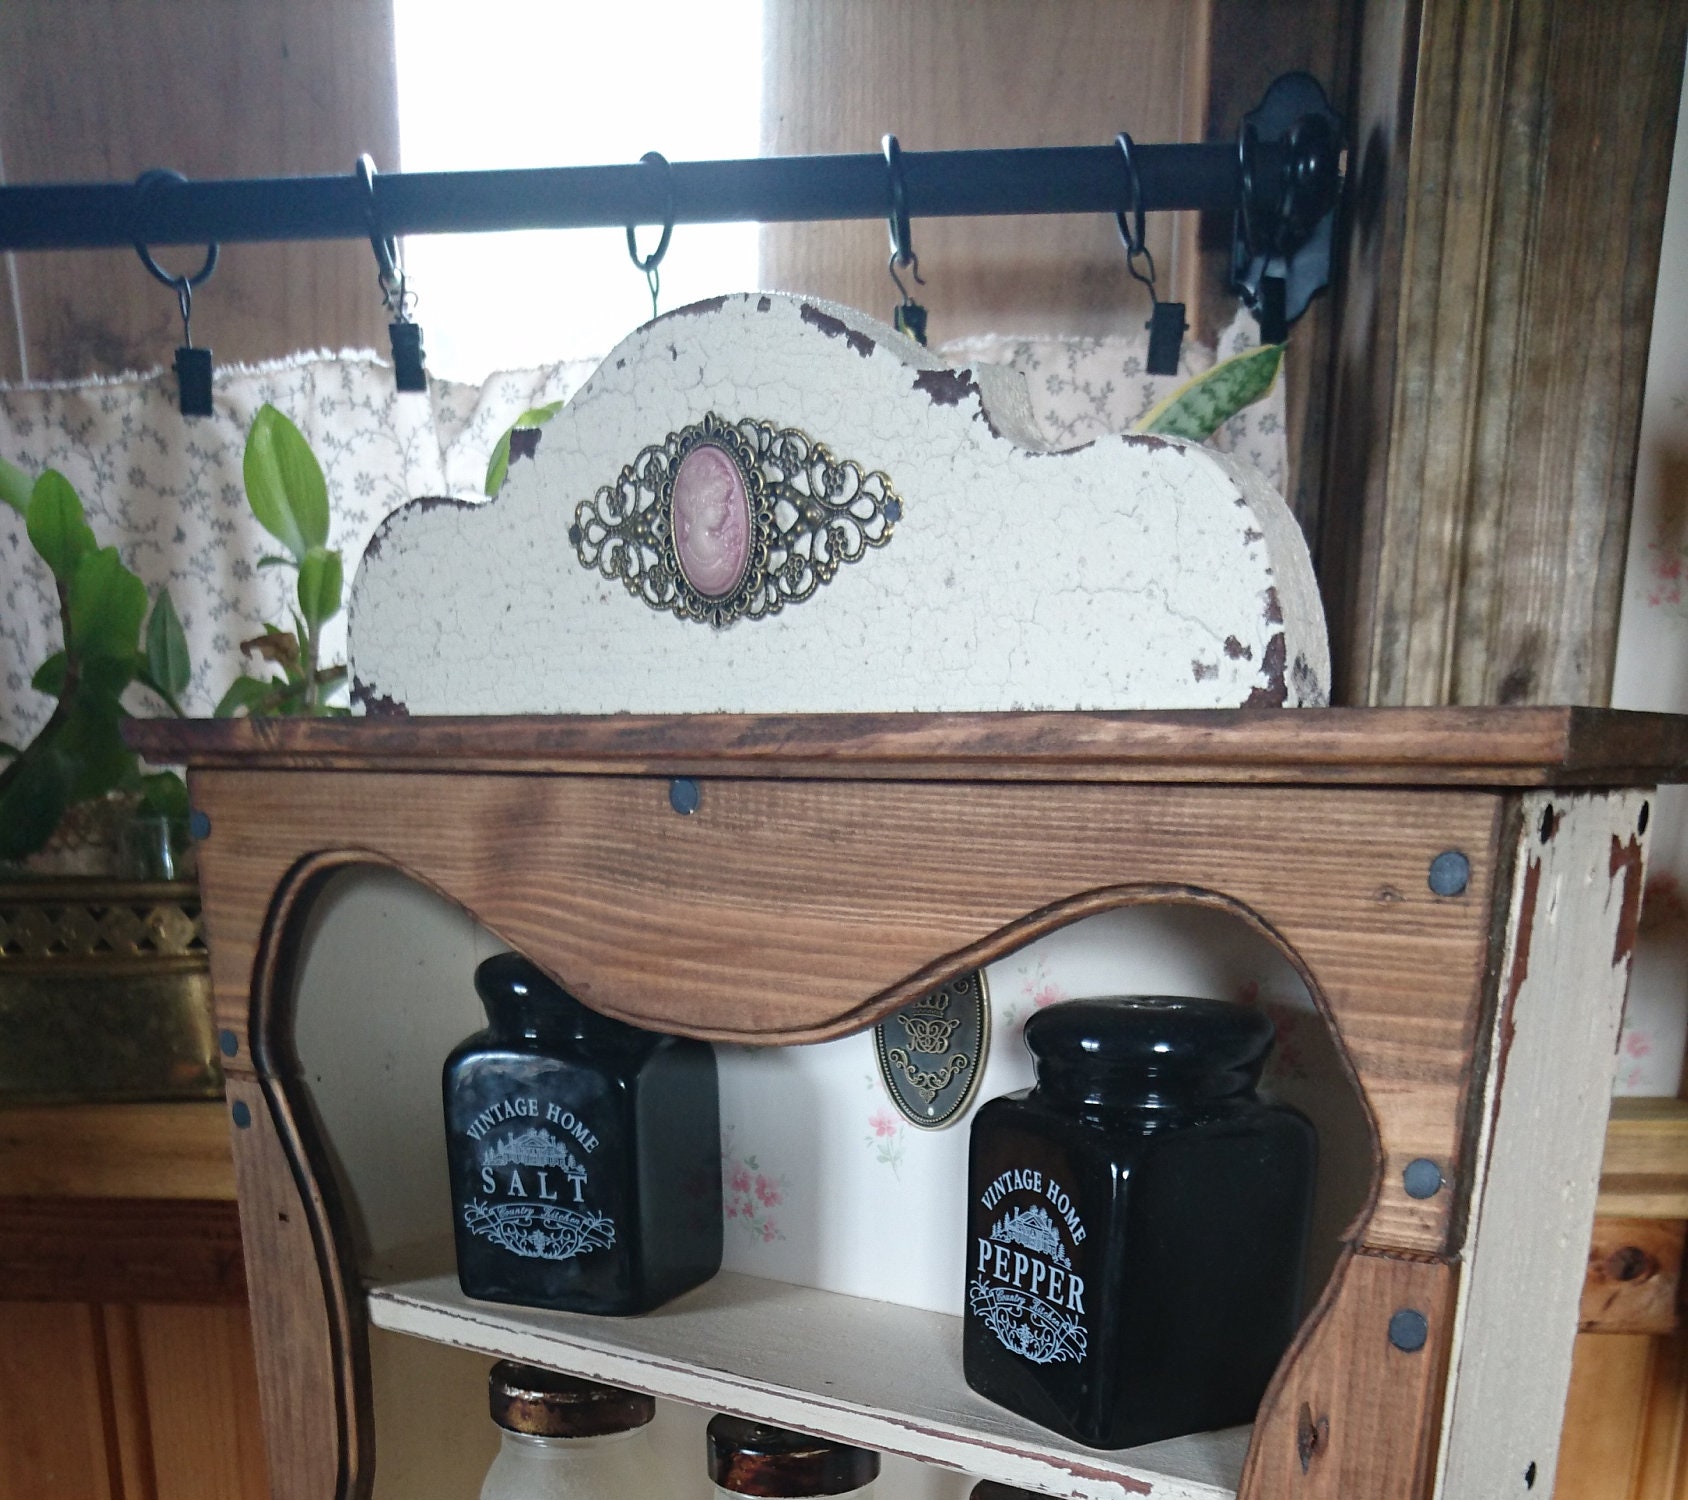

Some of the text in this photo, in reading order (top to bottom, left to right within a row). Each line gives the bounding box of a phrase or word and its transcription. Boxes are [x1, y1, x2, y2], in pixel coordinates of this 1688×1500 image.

[467, 1097, 599, 1153] VINTAGE HOME
[482, 1166, 588, 1202] SALT
[981, 1168, 1086, 1246] VINTAGE HOME
[499, 1206, 582, 1225] Country Kitchen
[977, 1238, 1085, 1314] PEPPER
[995, 1289, 1060, 1327] Country Kitchen
